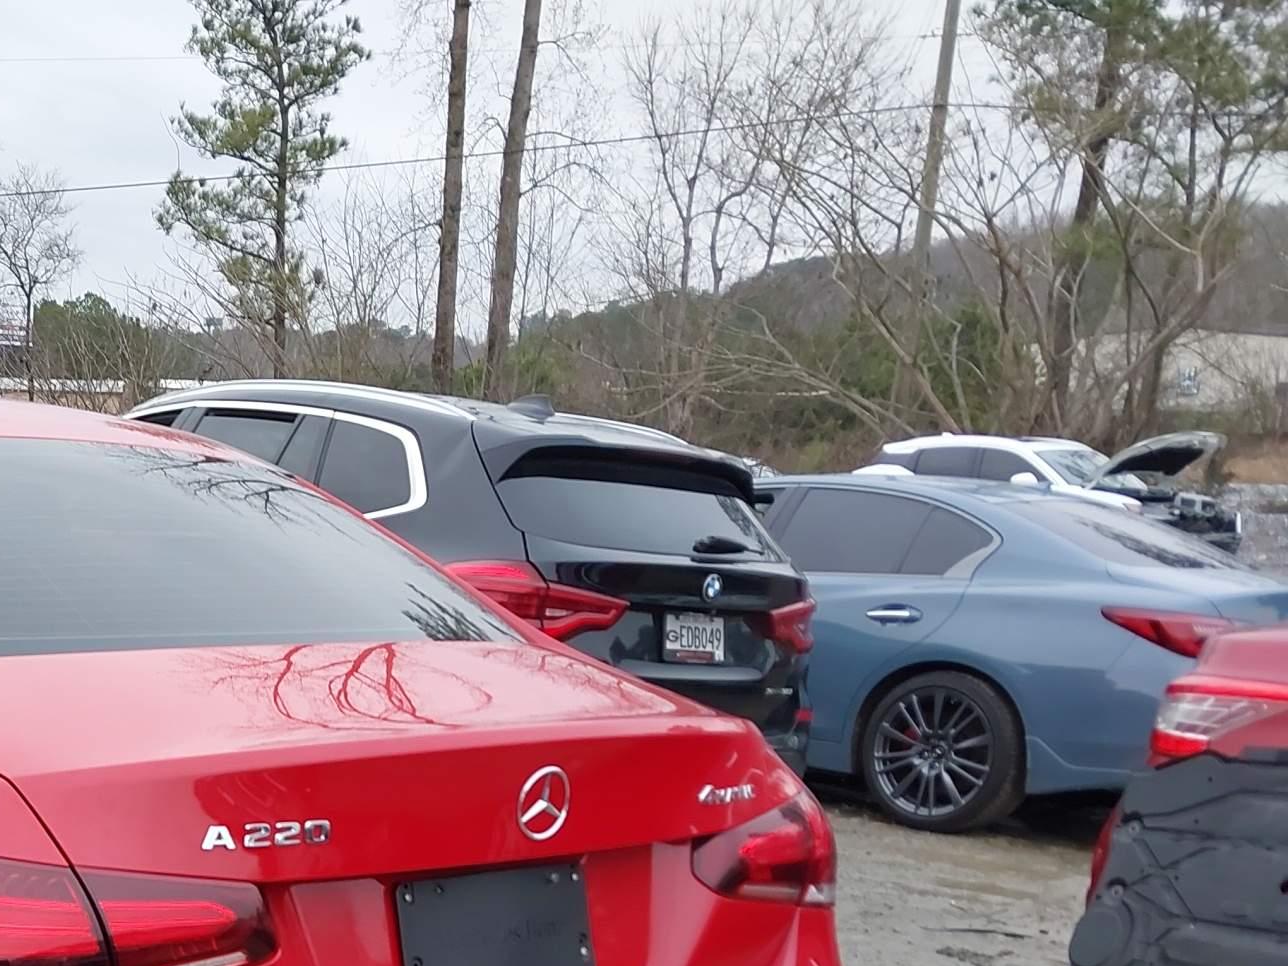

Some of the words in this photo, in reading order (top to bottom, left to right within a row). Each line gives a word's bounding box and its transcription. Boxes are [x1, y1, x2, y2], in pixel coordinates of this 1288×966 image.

[679, 625, 722, 650] EDB049
[201, 825, 237, 850] A
[243, 819, 331, 848] 220
